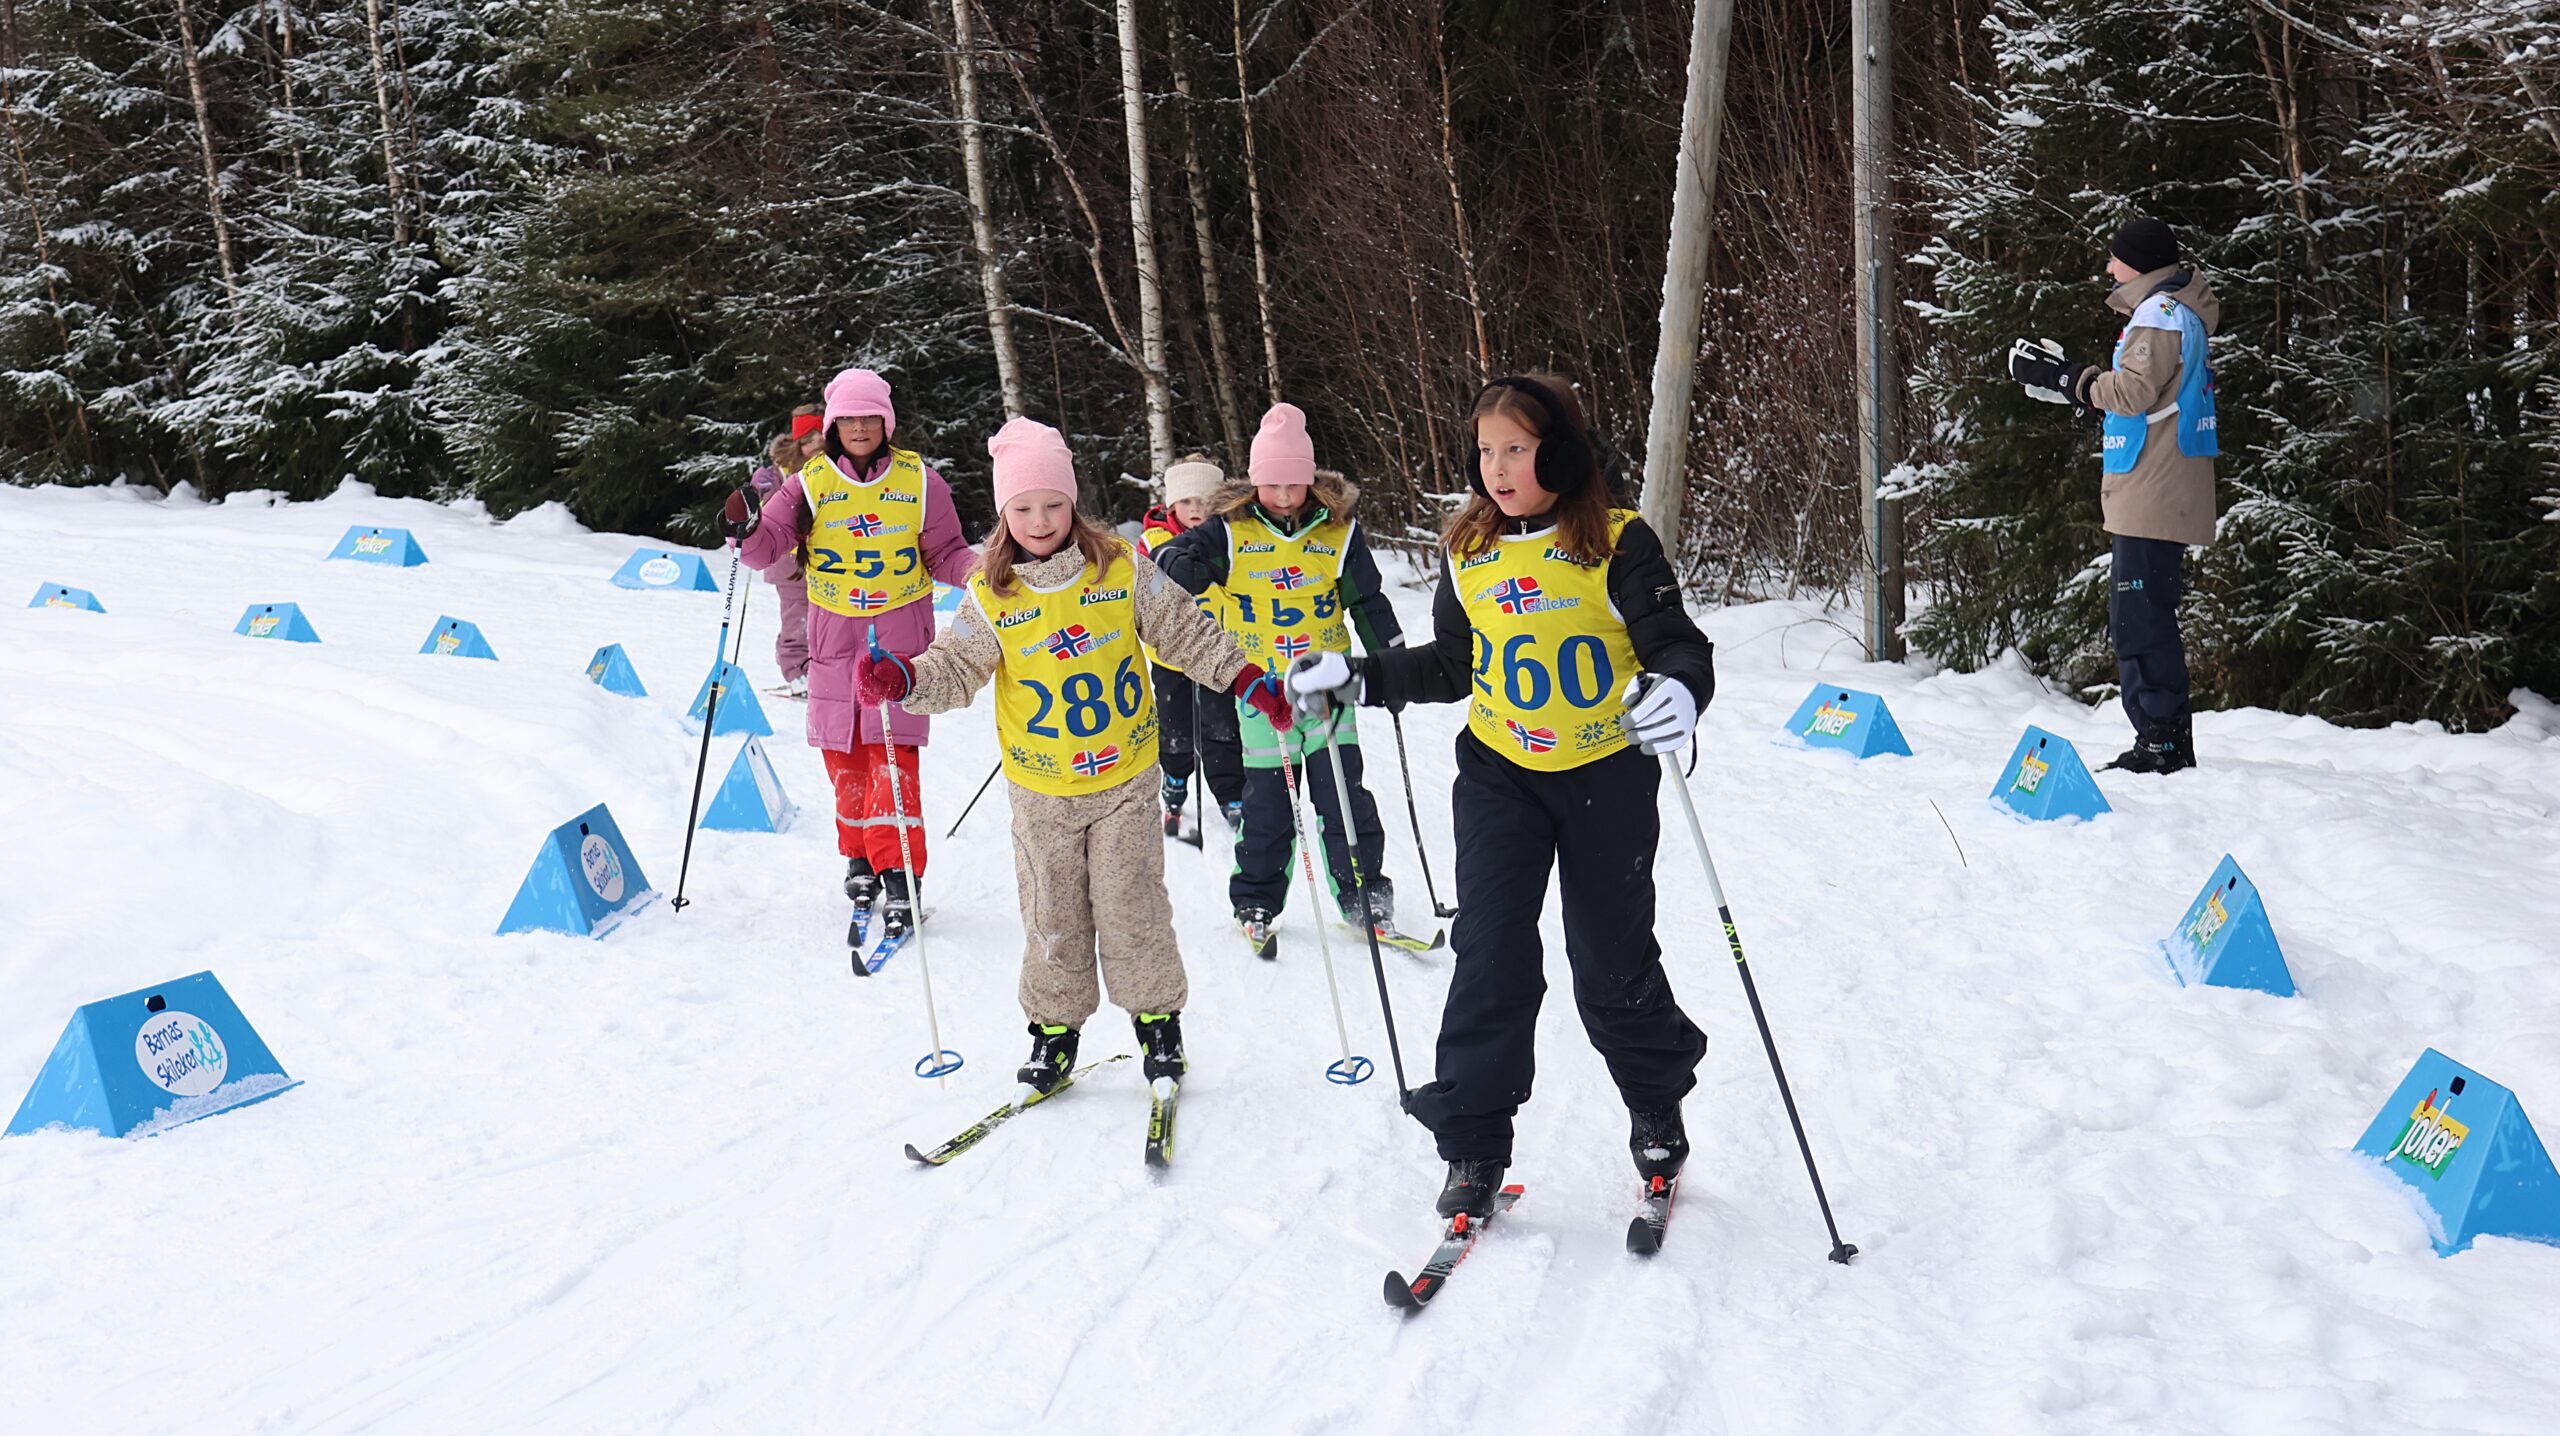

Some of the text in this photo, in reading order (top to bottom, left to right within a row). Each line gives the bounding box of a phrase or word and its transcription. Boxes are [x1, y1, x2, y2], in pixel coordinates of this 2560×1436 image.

[881, 487, 916, 503] joker
[1239, 540, 1275, 554] joker
[1305, 540, 1336, 556] joker
[724, 556, 739, 611] SALOMON
[1082, 586, 1126, 607] joker
[1000, 606, 1040, 629] joker
[1020, 633, 1060, 657] Barnas
[1471, 626, 1615, 711] 260
[1018, 655, 1143, 739] 286
[1804, 700, 1852, 737] joker
[2009, 747, 2046, 792] joker
[142, 1020, 184, 1056] Barnas
[156, 1048, 200, 1088] Skileker
[2385, 1088, 2461, 1170] joker
